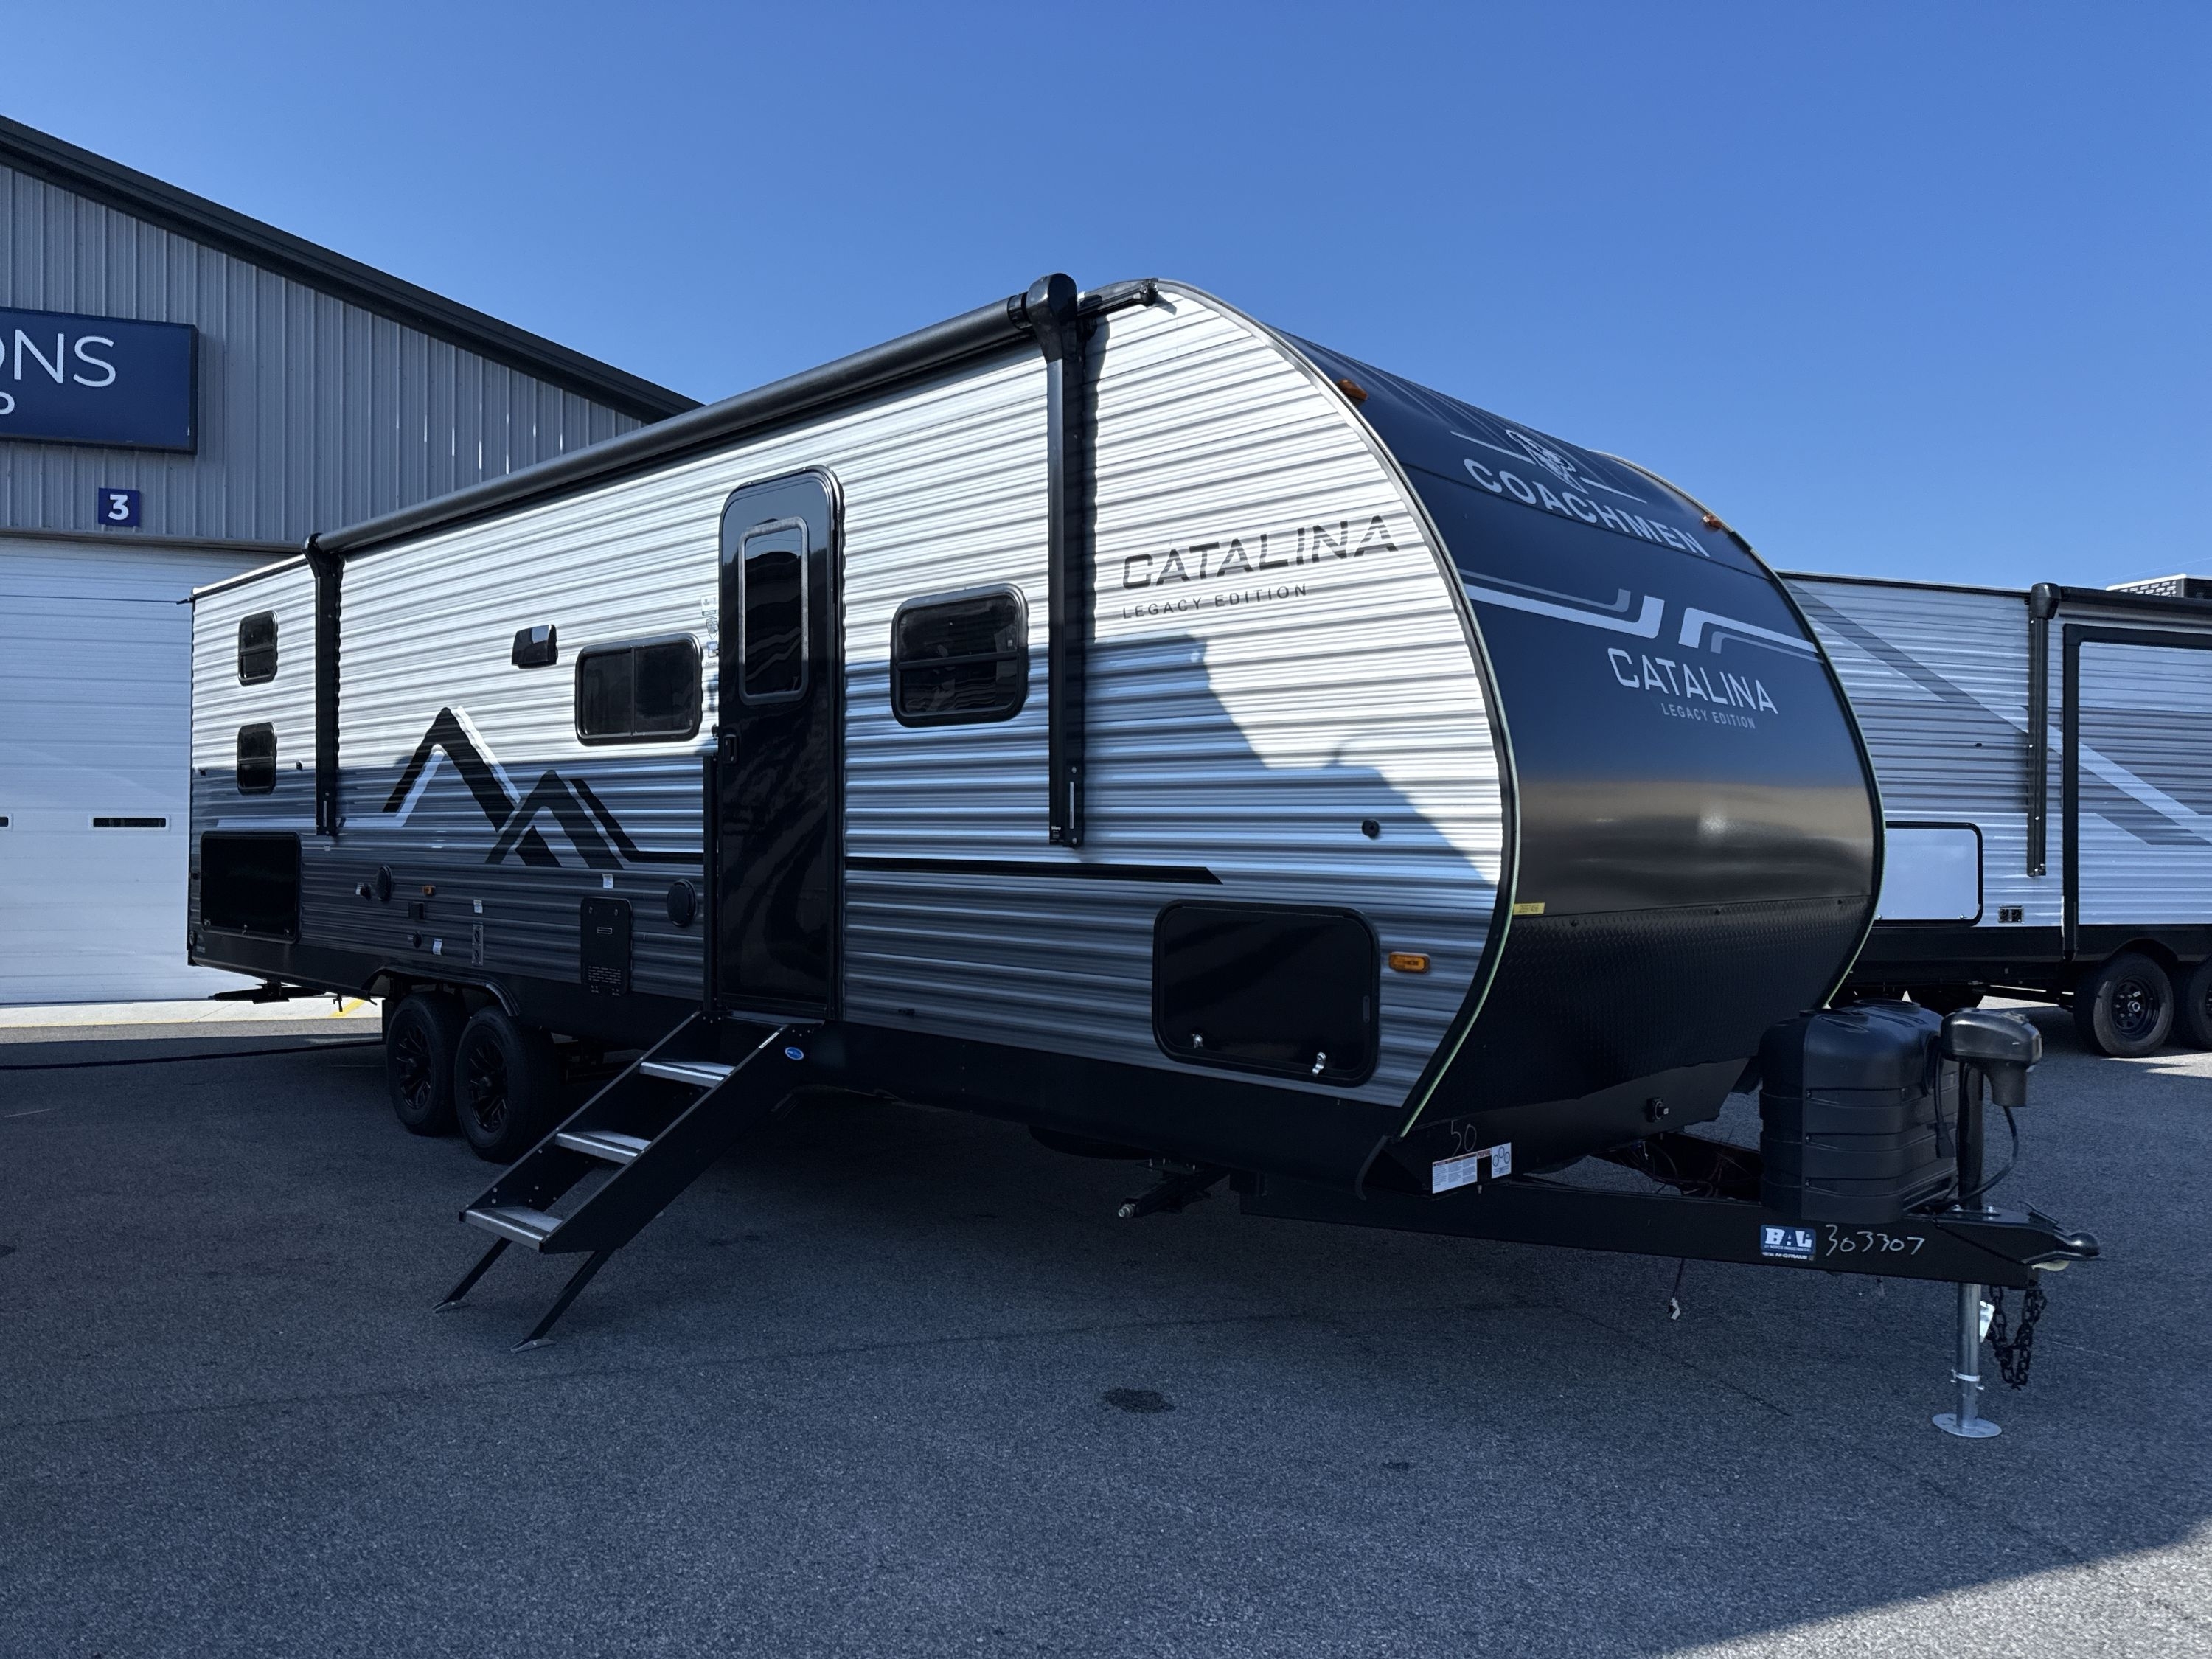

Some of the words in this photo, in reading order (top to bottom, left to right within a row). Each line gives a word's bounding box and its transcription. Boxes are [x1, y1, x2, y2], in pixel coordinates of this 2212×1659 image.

[0, 329, 116, 388] NS
[108, 494, 129, 521] 3
[1463, 459, 1711, 557] COACHMEN
[1122, 515, 1399, 590] CATALINA
[1122, 597, 1202, 619] LEGACY
[1214, 584, 1307, 607] EDITION
[1607, 647, 1778, 714] CATALINA
[1663, 703, 1708, 721] LEGACY
[1711, 711, 1756, 729] EDITION
[1450, 1119, 1478, 1158] 50
[1825, 1224, 1926, 1256] 303307
